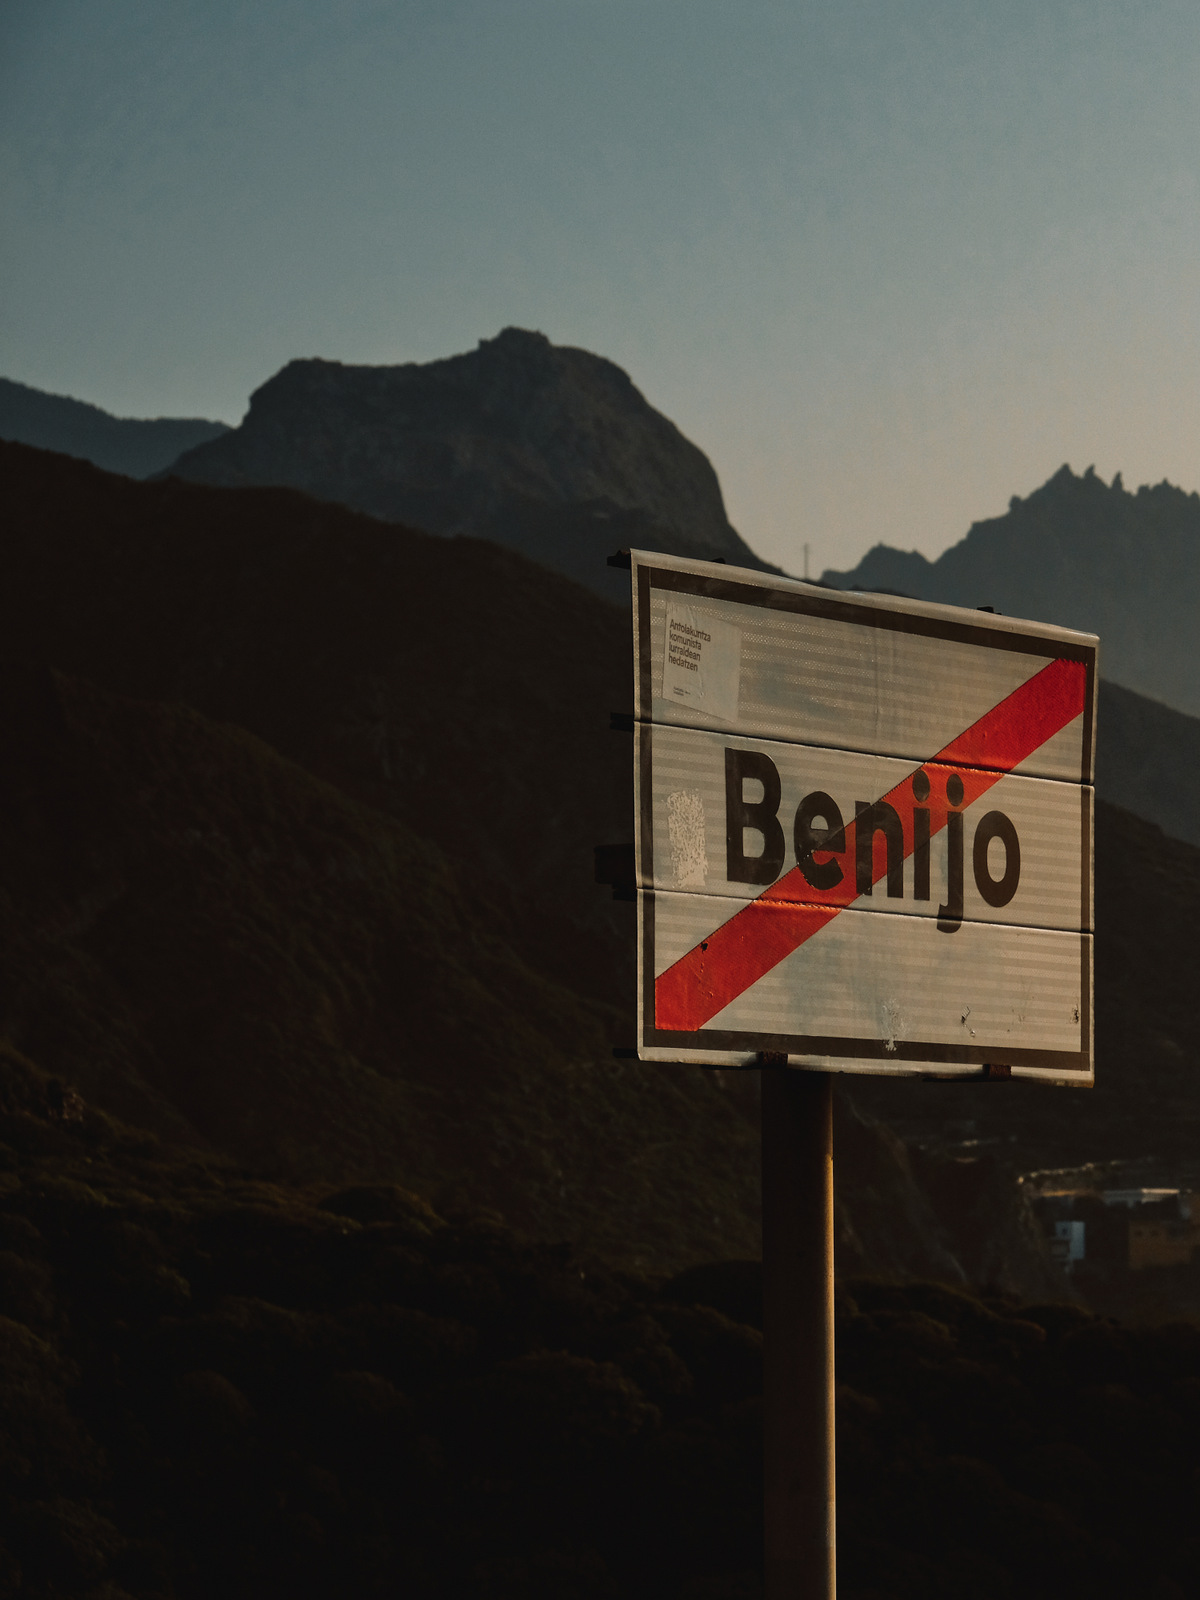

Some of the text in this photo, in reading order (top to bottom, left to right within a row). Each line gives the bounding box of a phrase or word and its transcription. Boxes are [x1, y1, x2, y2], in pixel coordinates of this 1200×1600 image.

[669, 630, 702, 650] komunista
[670, 619, 711, 642] Antolakuntza
[669, 641, 701, 662] lurraldean
[669, 652, 699, 672] hedatzen
[724, 746, 1021, 934] Benijo
